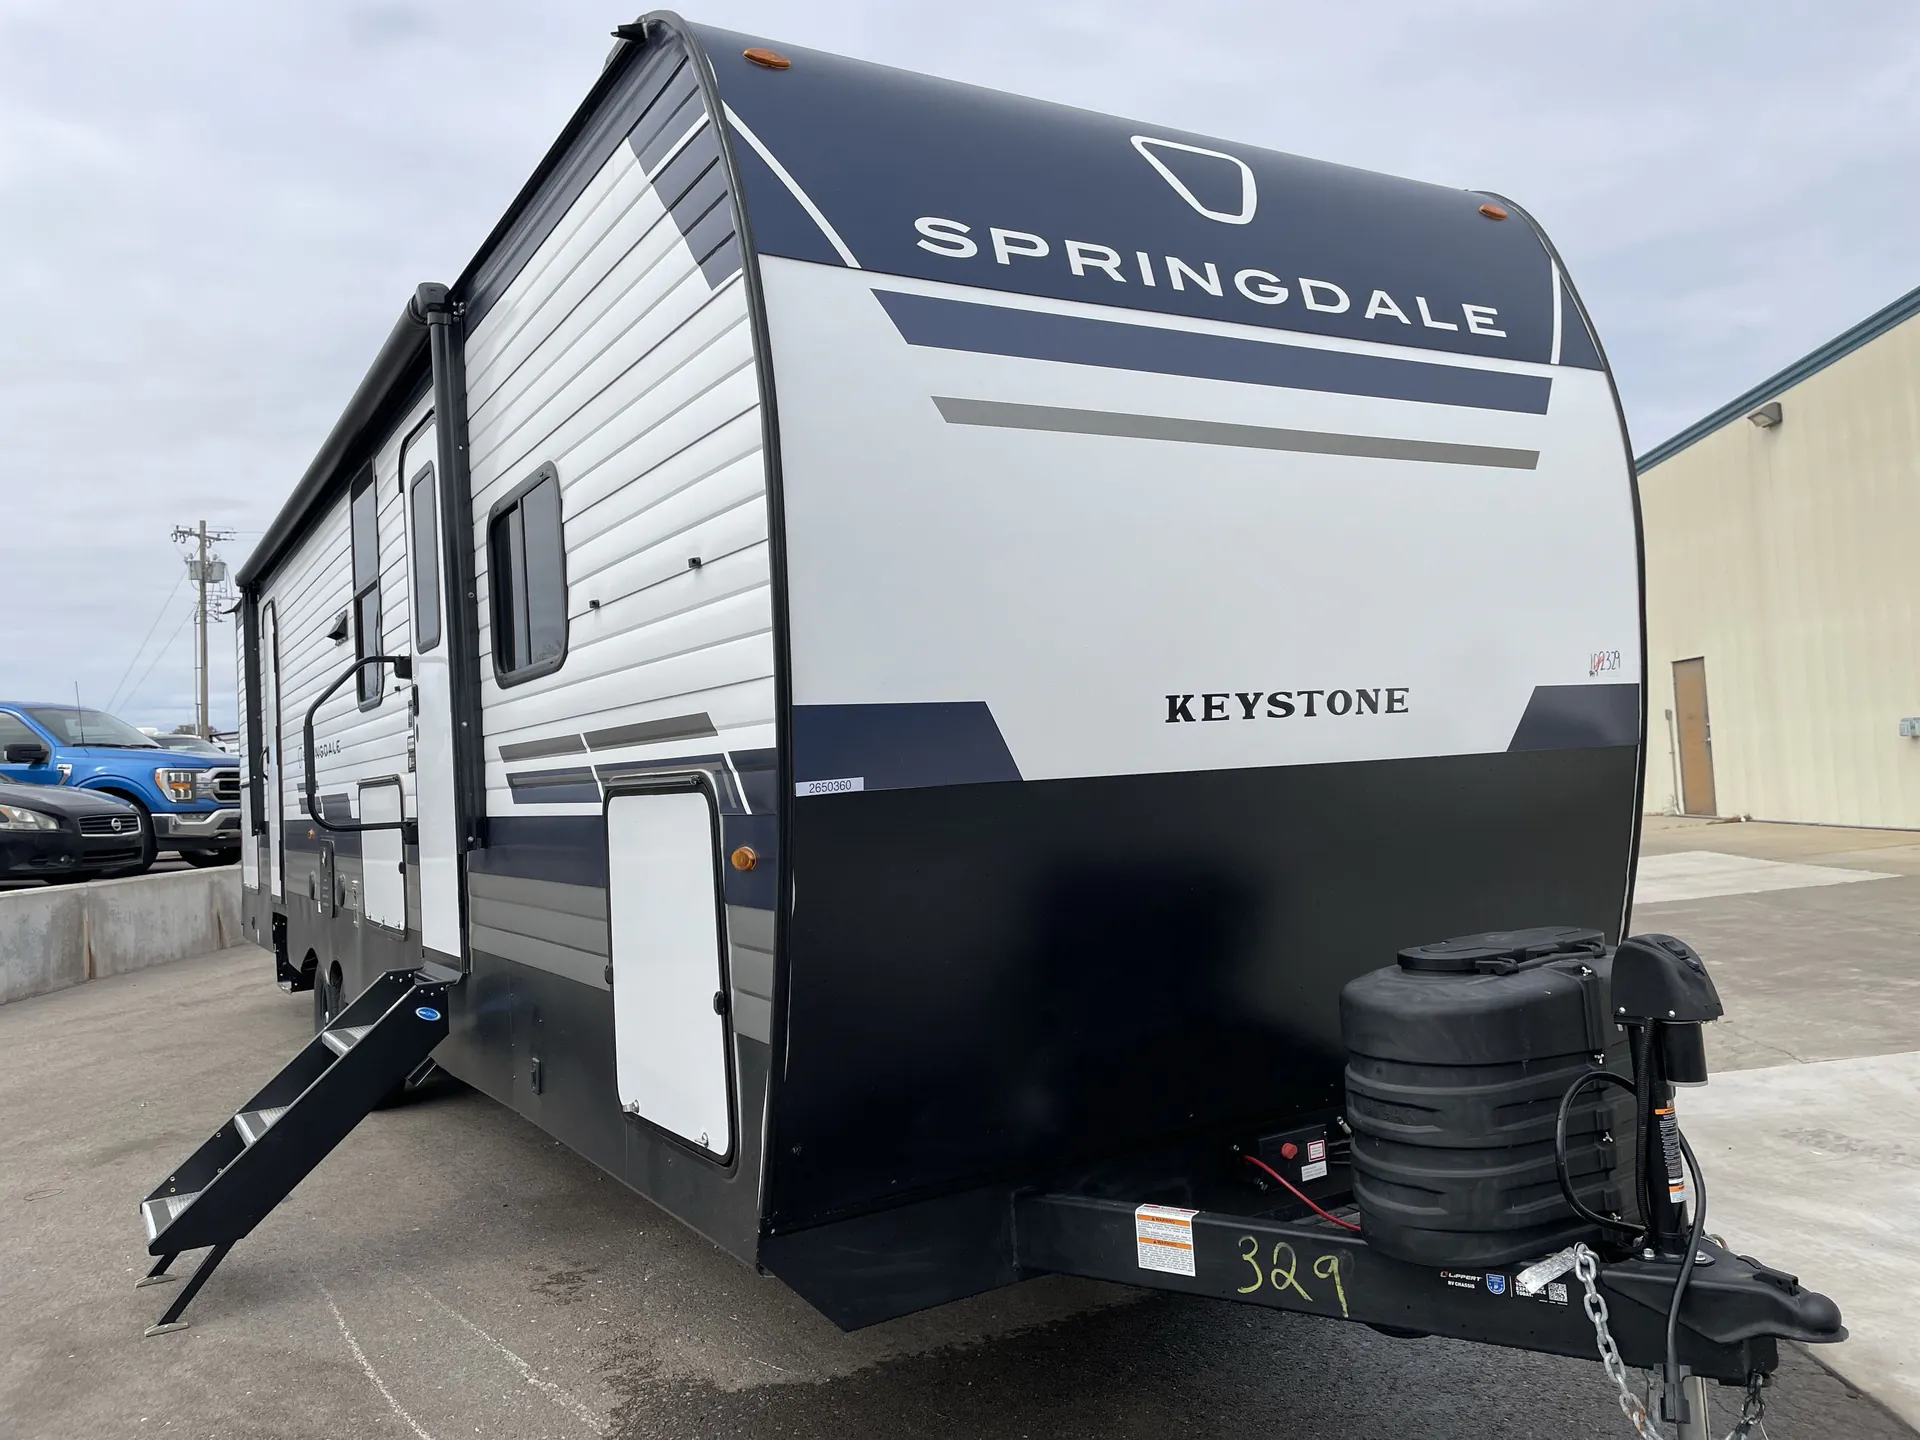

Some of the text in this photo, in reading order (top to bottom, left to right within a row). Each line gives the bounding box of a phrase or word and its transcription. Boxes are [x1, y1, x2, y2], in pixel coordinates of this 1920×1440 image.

[914, 216, 1507, 338] SPRINGDALE
[1165, 687, 1410, 724] KEYSTONE
[808, 780, 852, 794] 2650360
[1237, 1235, 1349, 1318] 329
[1448, 1272, 1482, 1282] LIPPERT
[1454, 1281, 1475, 1289] CHASSIS
